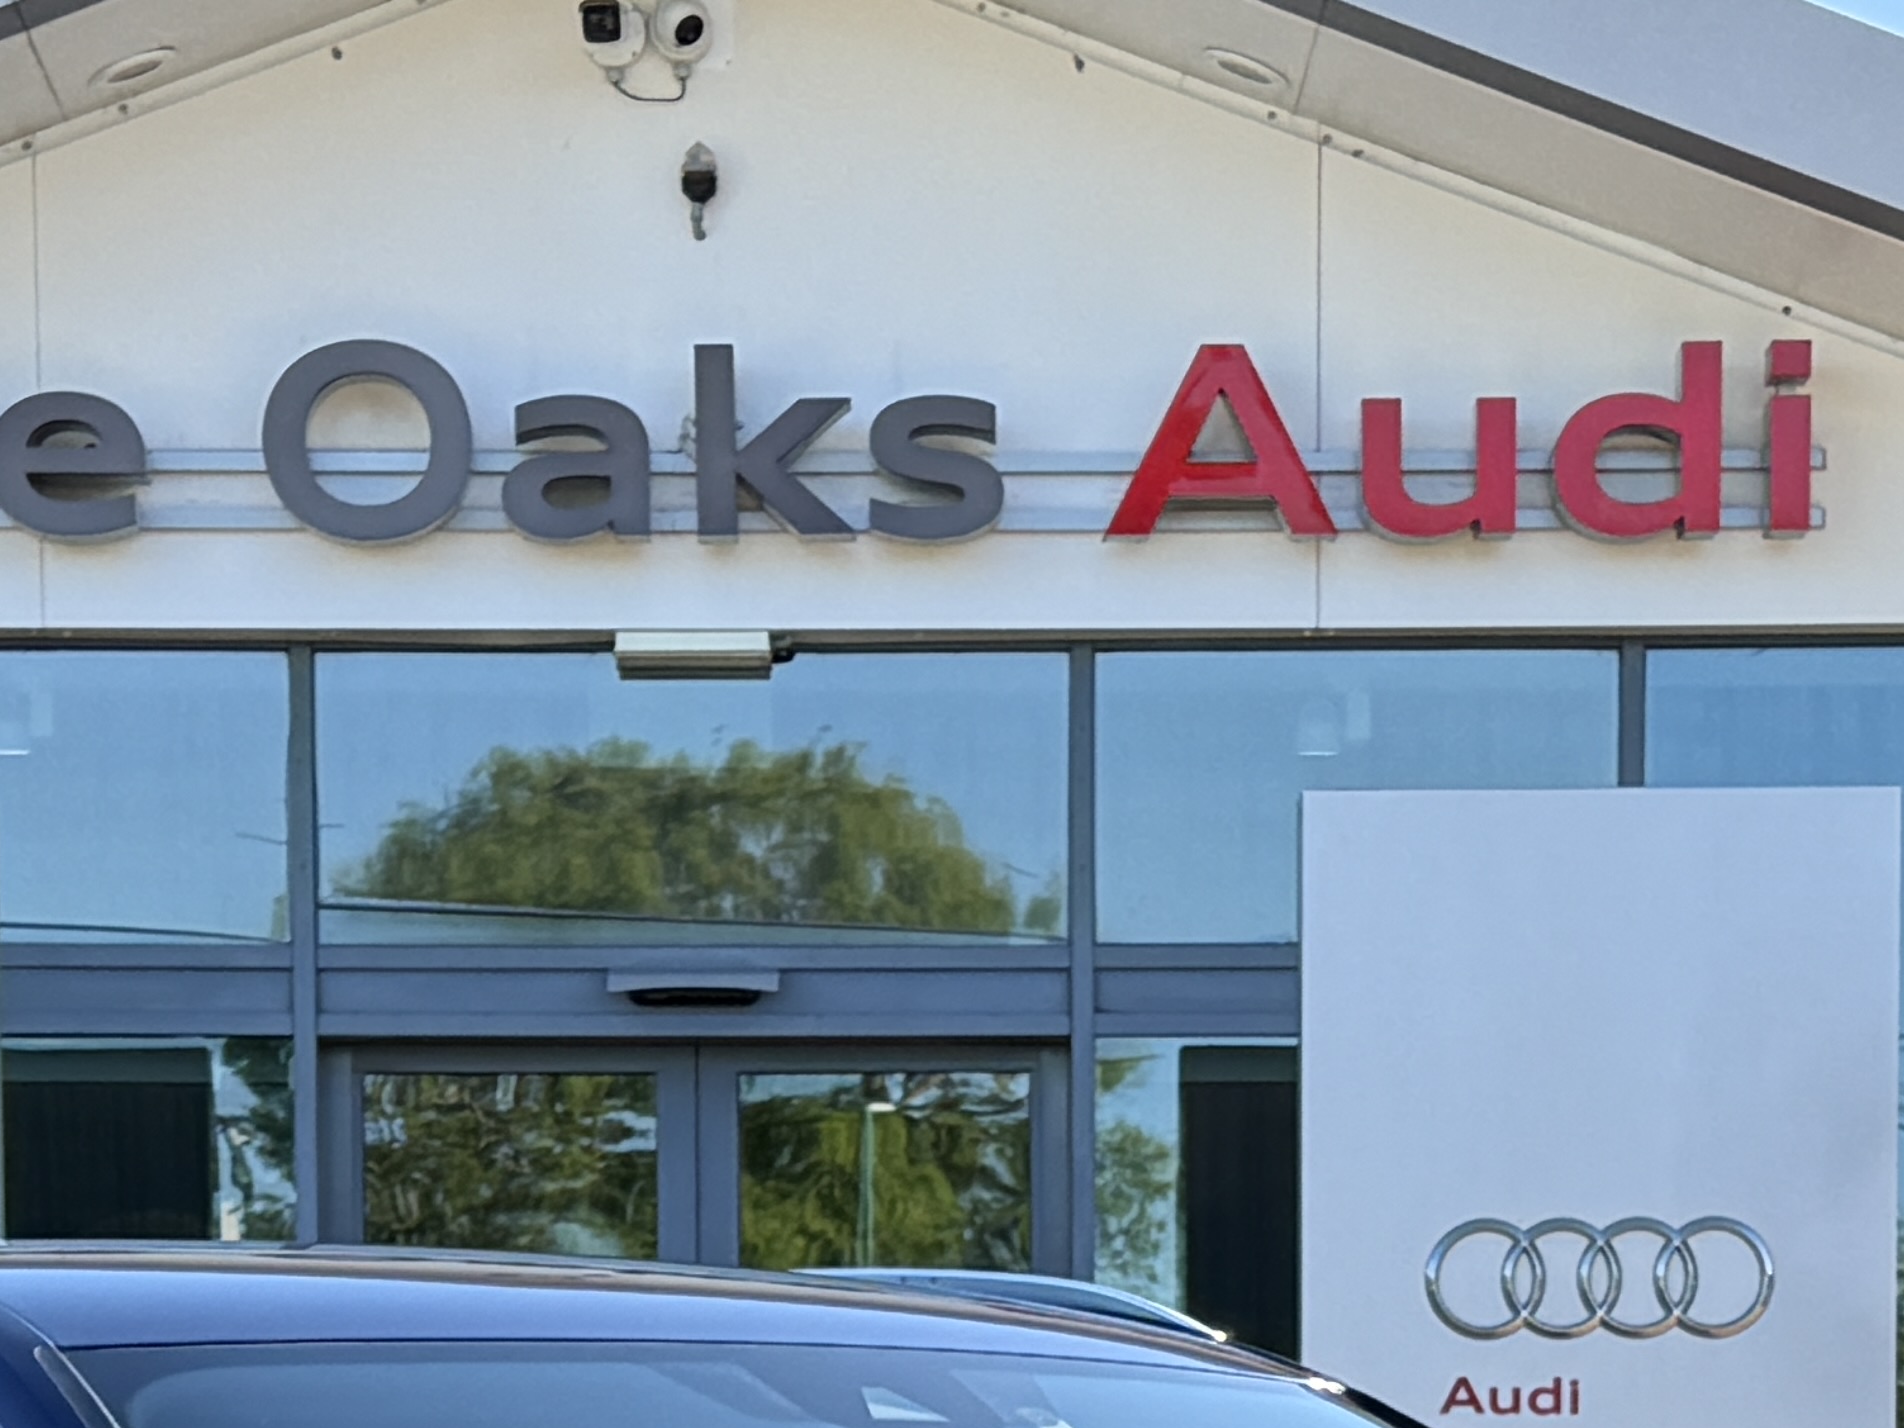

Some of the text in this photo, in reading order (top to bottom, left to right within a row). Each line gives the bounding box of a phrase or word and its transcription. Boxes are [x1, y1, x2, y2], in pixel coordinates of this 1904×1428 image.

[262, 338, 1004, 545] Oaks
[1102, 340, 1813, 543] Audi
[1439, 1376, 1581, 1416] Audi
